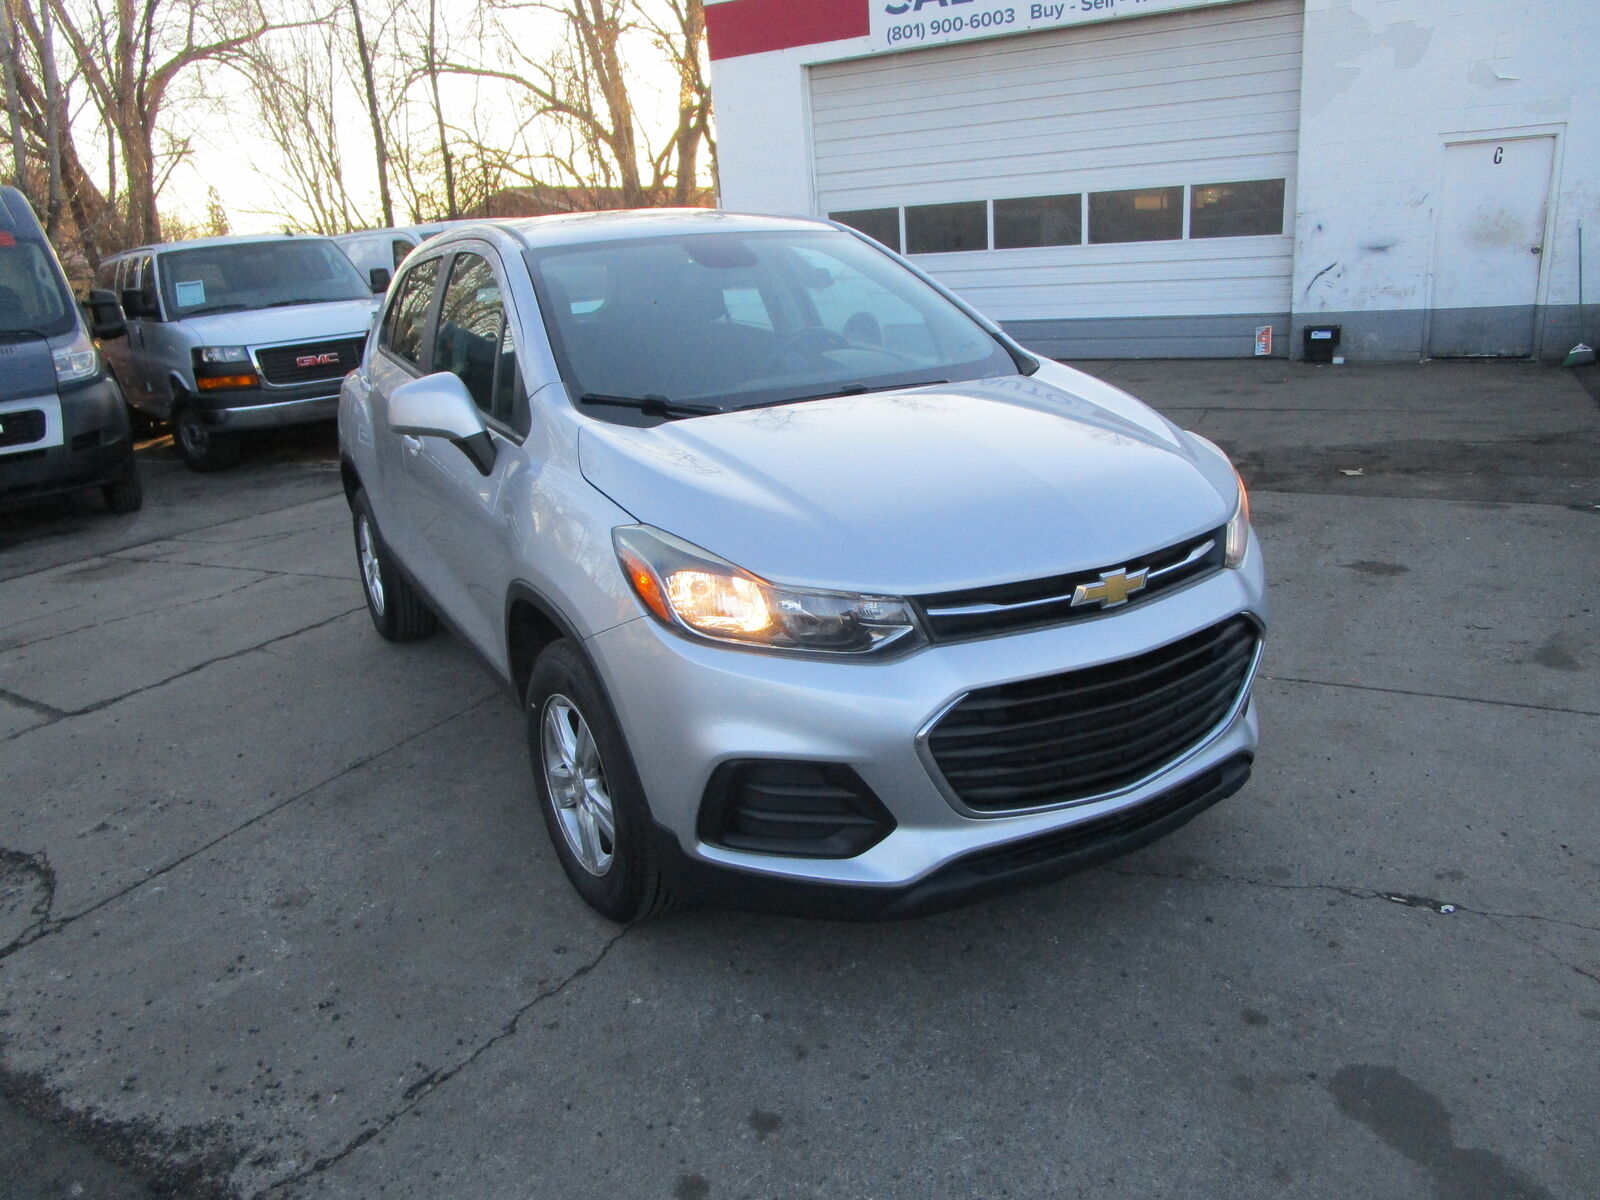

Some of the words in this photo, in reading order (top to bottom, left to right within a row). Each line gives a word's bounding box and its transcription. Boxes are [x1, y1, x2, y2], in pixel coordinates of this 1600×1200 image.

[887, 23, 925, 45] (801)
[930, 8, 1015, 35] 900-6003
[1031, 3, 1064, 20] Buy
[296, 352, 339, 367] GMC
